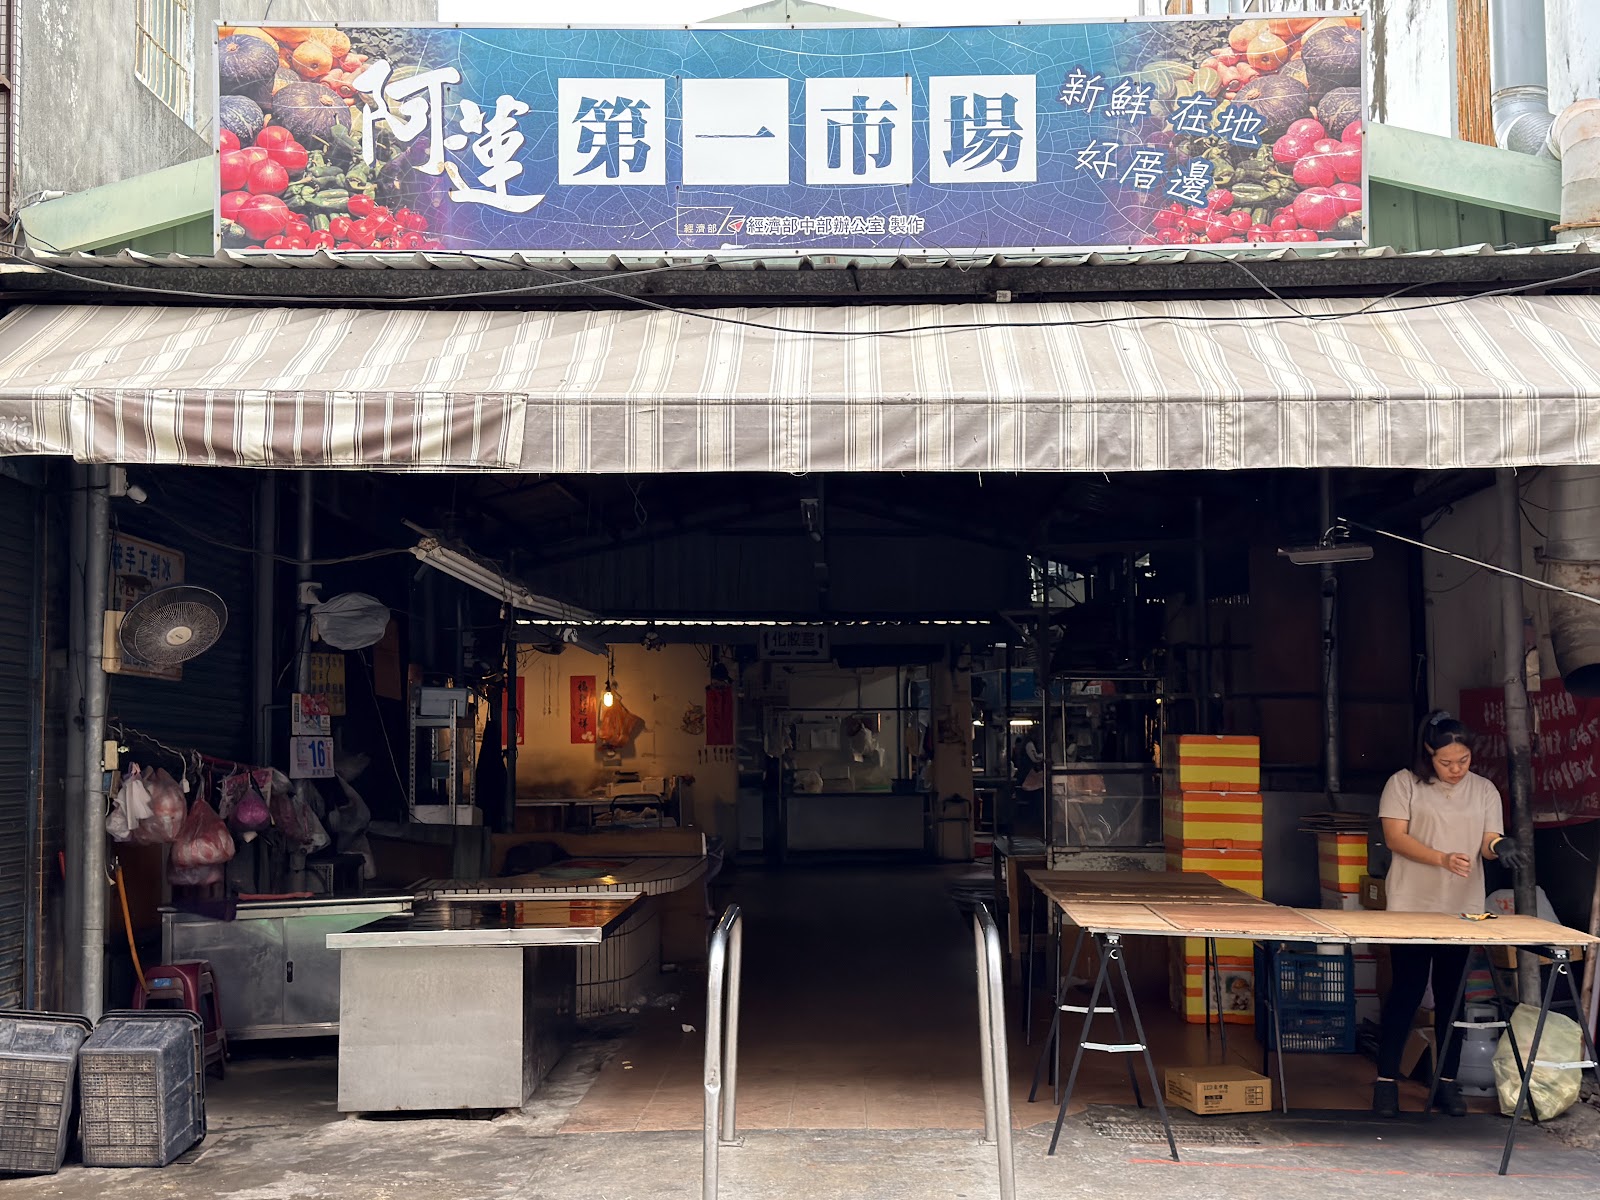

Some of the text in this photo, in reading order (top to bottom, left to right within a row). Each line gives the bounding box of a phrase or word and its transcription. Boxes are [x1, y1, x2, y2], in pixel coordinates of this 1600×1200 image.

[1060, 68, 1262, 145] 新鮮 在地
[352, 59, 1024, 213] 阿蓮 第一市場
[1074, 139, 1211, 205] 好厝邊
[683, 223, 718, 234] 經濟部
[746, 215, 925, 236] 經濟部中部辦公室 製作
[308, 740, 326, 768] 16
